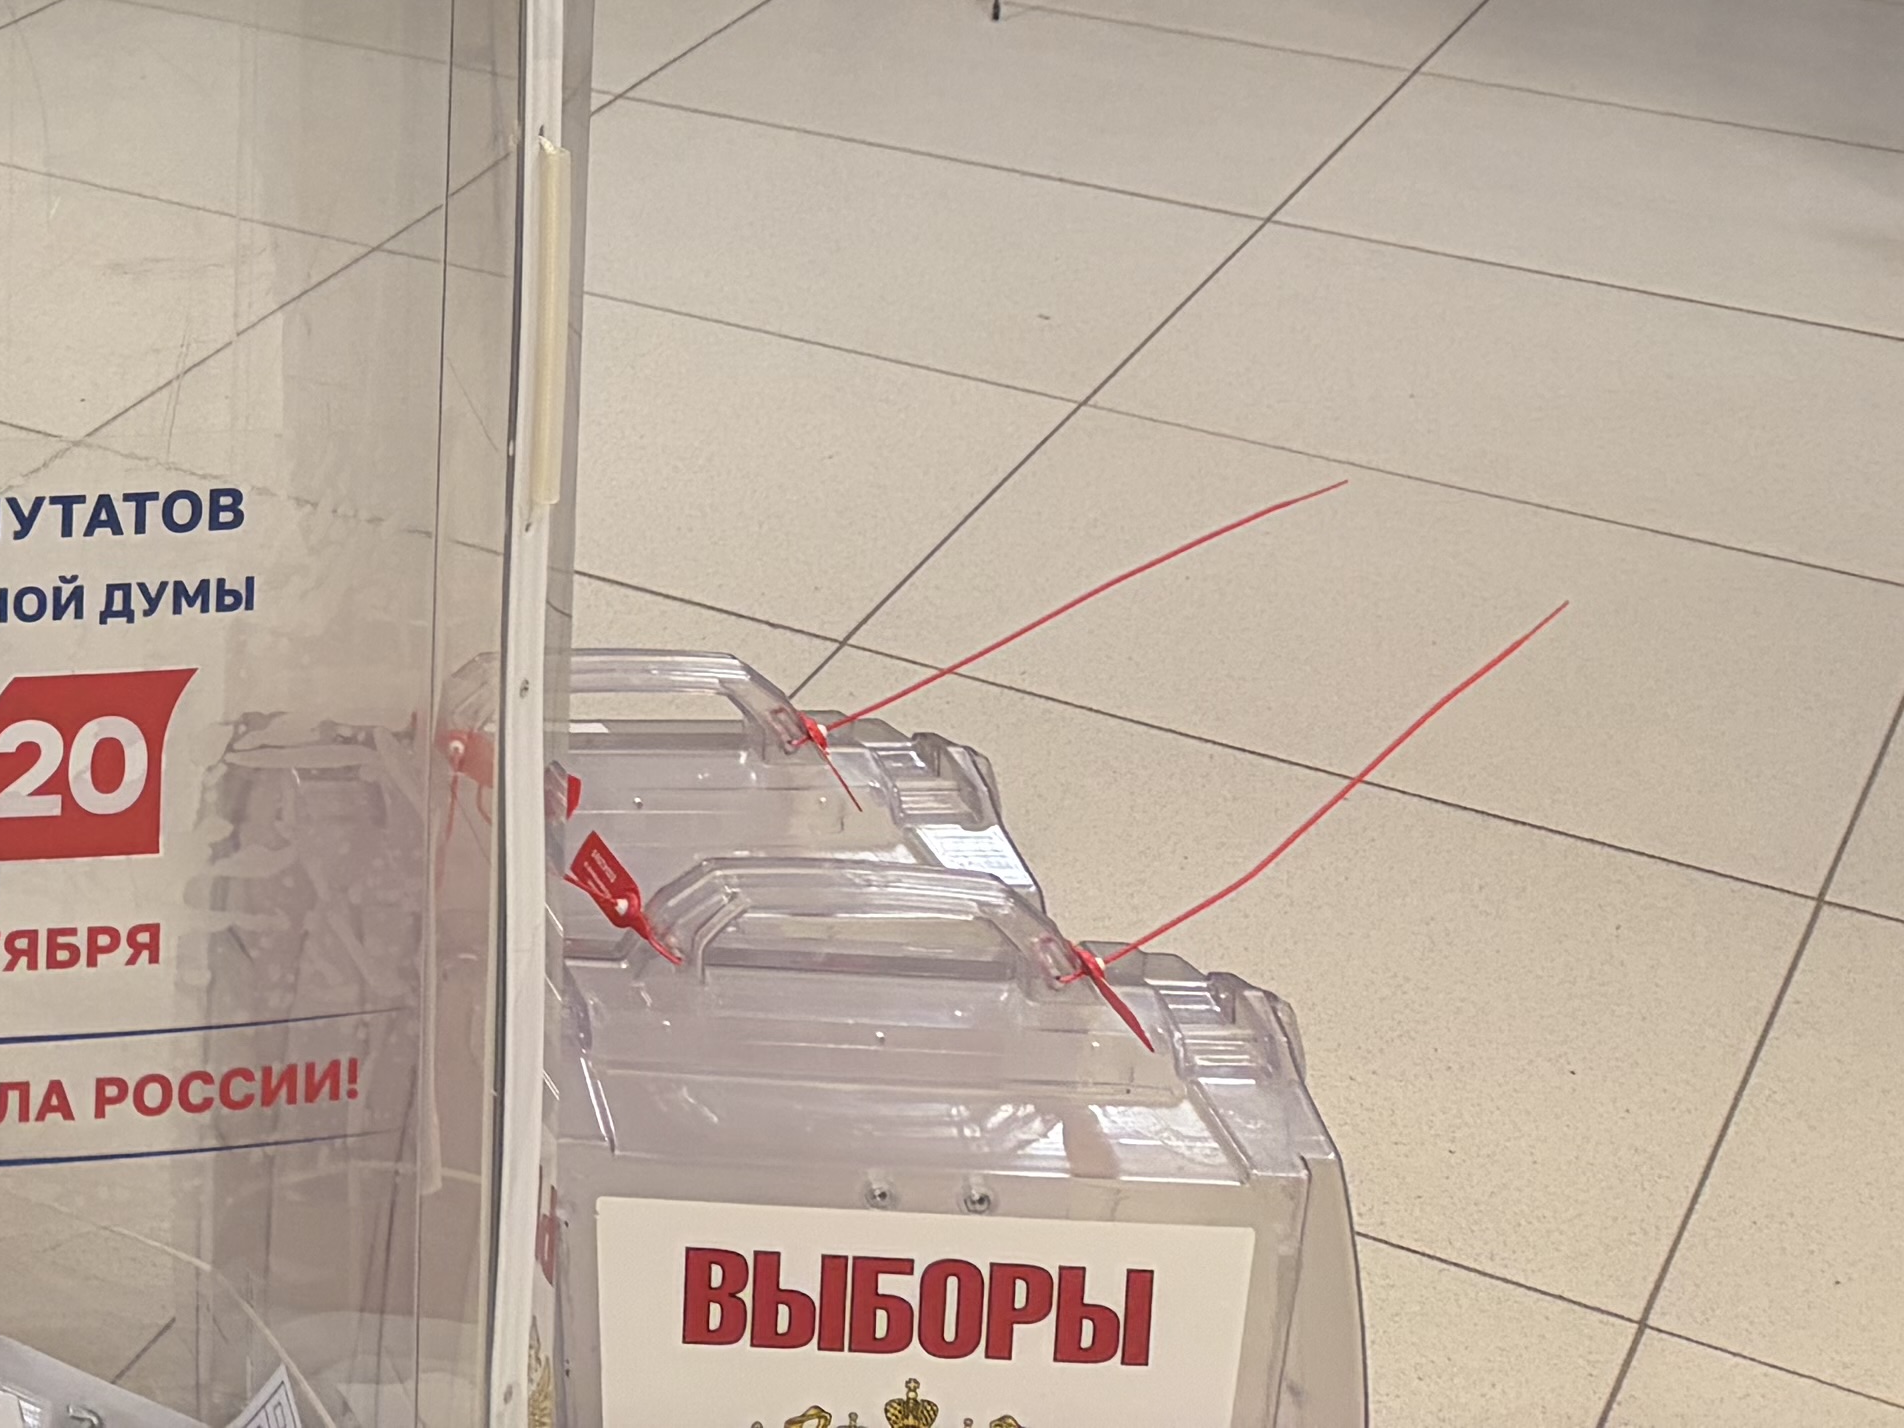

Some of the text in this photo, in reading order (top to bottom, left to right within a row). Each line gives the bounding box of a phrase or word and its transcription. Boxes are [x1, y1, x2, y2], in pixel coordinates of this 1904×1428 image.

[100, 575, 255, 624] ДУМЫ
[93, 1060, 359, 1119] РОССИИ!
[682, 1246, 1155, 1367] ВЫБОРЫ
